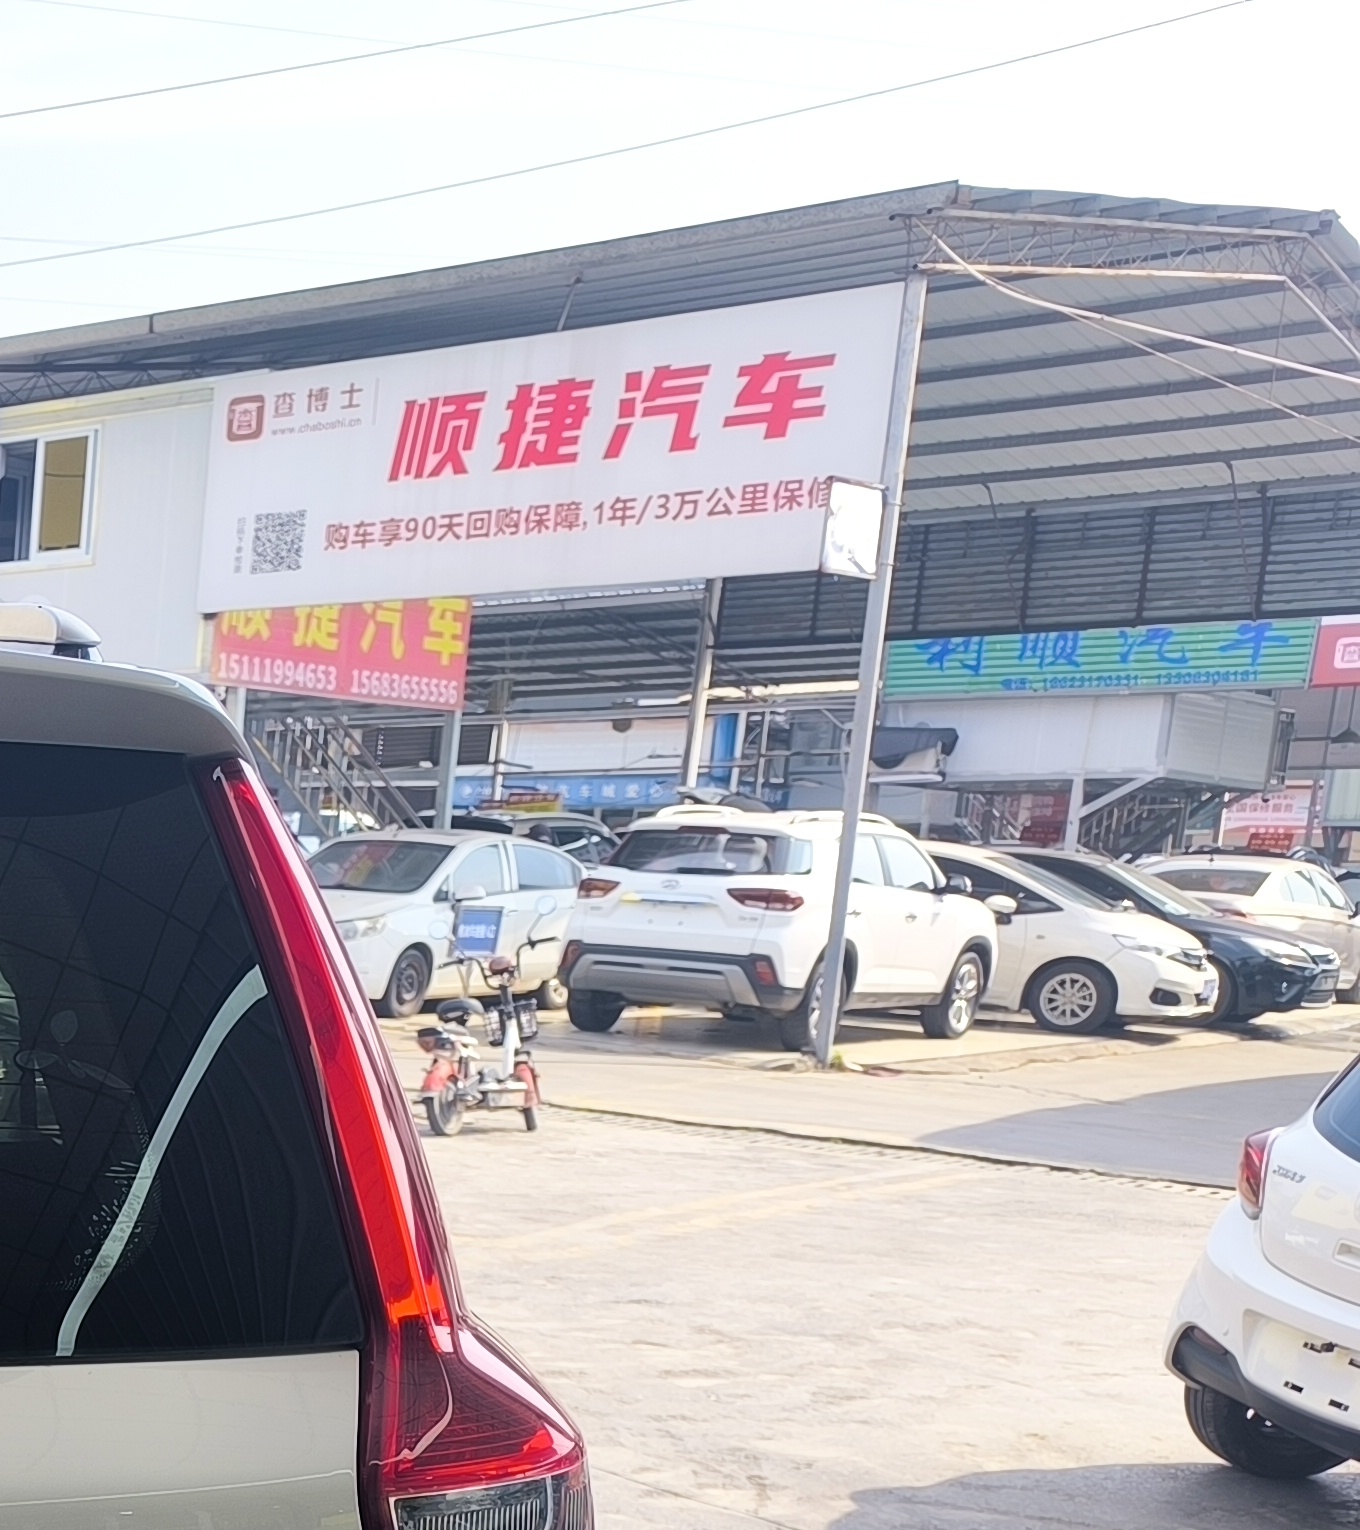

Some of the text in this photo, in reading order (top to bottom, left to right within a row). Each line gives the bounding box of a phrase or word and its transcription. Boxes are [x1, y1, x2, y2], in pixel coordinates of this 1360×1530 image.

[272, 382, 364, 419] 查博士
[388, 350, 837, 482] 顺捷汽车
[916, 622, 1290, 675] 利顺汽车
[218, 652, 337, 692] 15111994653
